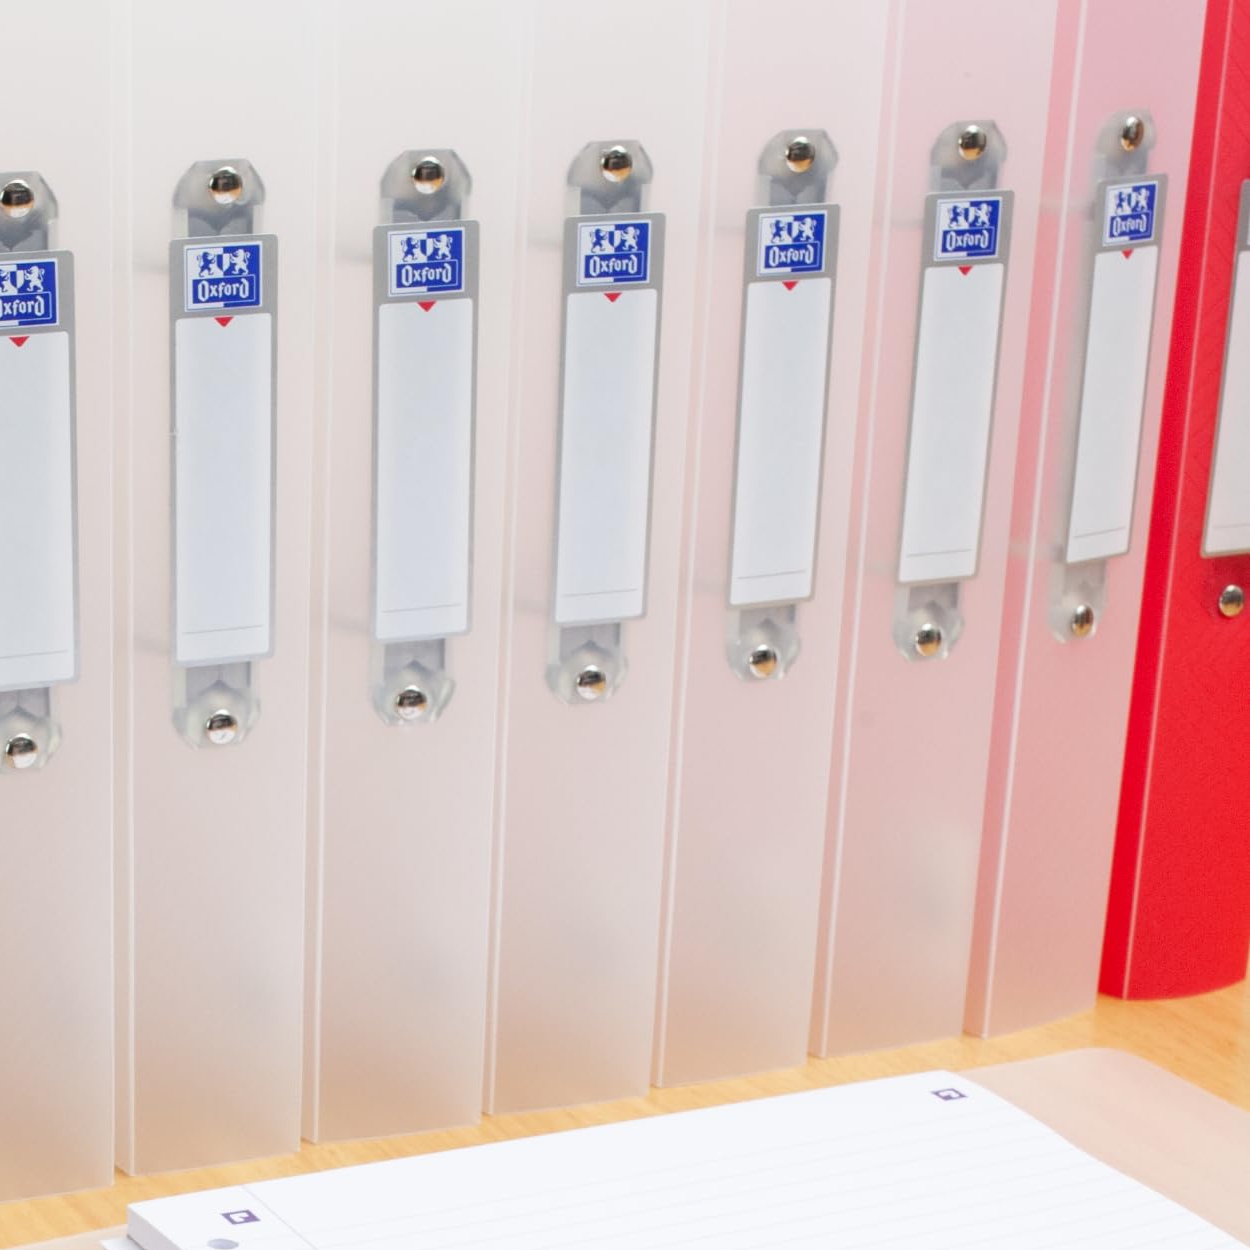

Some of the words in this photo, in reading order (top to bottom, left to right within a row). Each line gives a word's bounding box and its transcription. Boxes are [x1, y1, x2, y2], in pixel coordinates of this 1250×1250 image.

[1113, 215, 1146, 236] Oxford
[946, 229, 988, 249] Oxford
[590, 253, 637, 275] Oxford
[769, 245, 813, 266] Oxford
[402, 263, 452, 286] Oxford
[198, 278, 249, 300] Oxford
